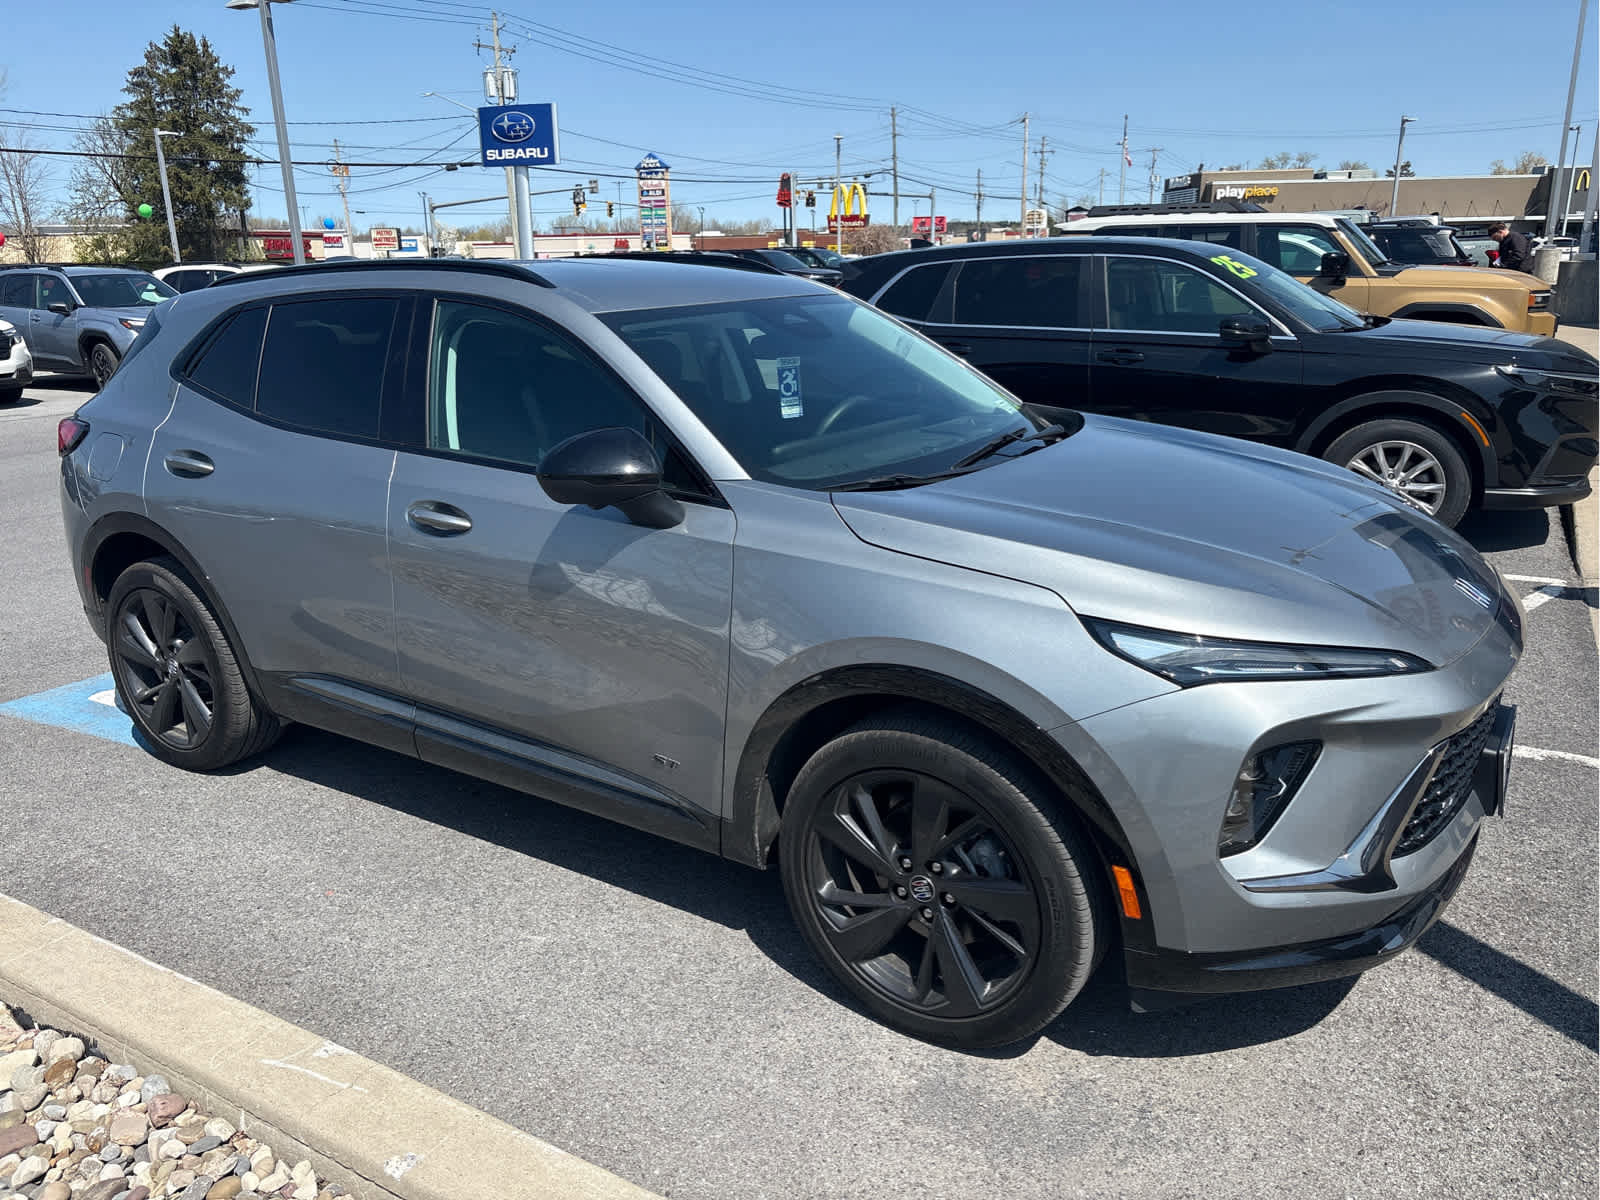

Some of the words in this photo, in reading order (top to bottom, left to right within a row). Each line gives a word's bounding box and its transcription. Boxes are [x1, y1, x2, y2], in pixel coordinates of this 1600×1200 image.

[486, 147, 549, 160] SUBARU
[1216, 185, 1280, 200] playplace
[1210, 255, 1259, 279] 25
